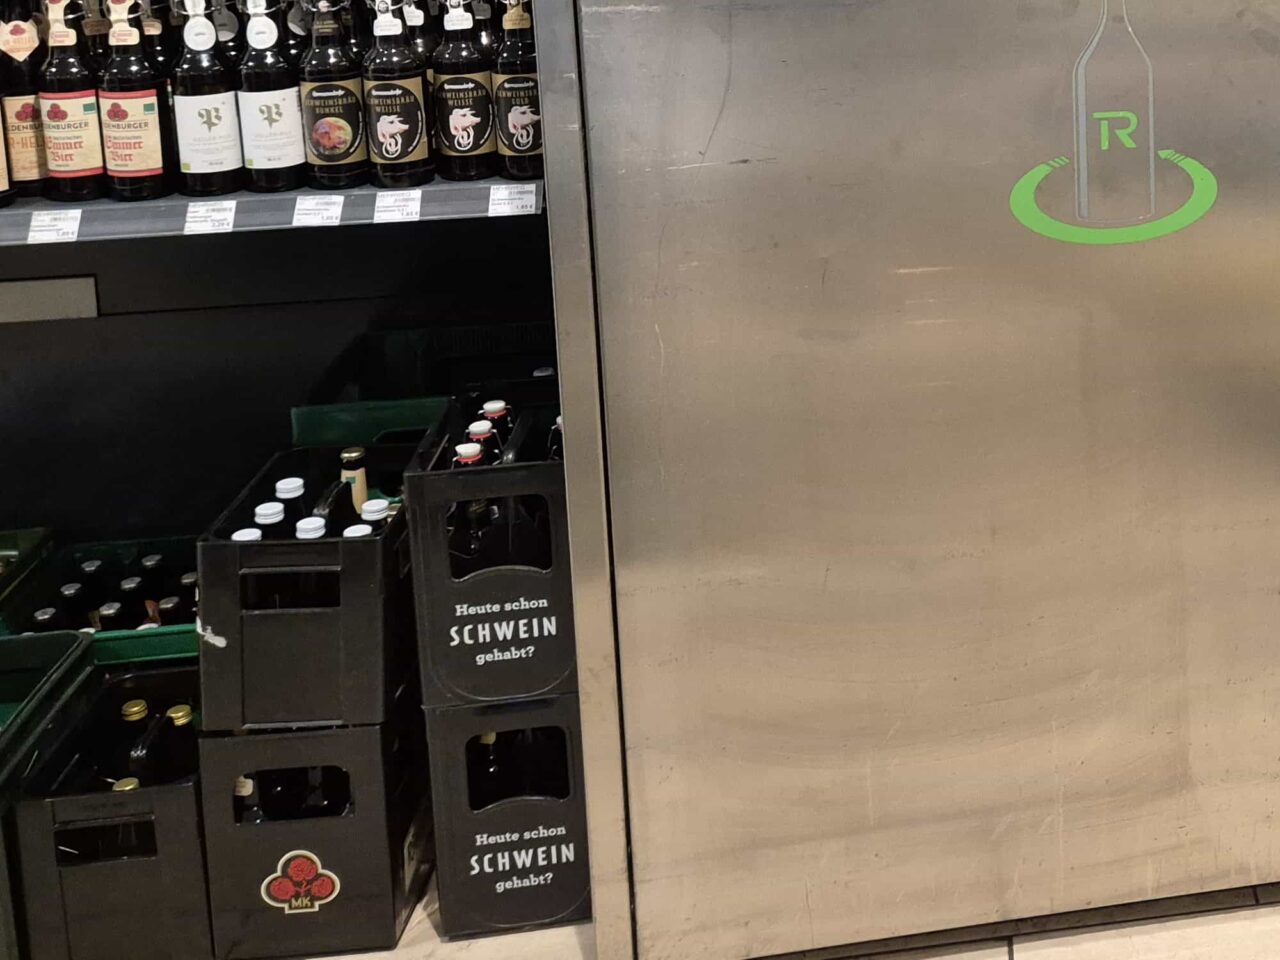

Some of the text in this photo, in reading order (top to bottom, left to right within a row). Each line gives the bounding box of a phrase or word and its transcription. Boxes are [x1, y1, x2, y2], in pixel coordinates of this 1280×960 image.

[455, 597, 548, 616] Heute schon
[449, 616, 557, 646] SCHWEIN
[475, 646, 535, 666] gehabt?
[475, 824, 567, 847] Heute schon
[469, 843, 575, 876] SCHWEIN
[495, 872, 554, 894] gehabt?
